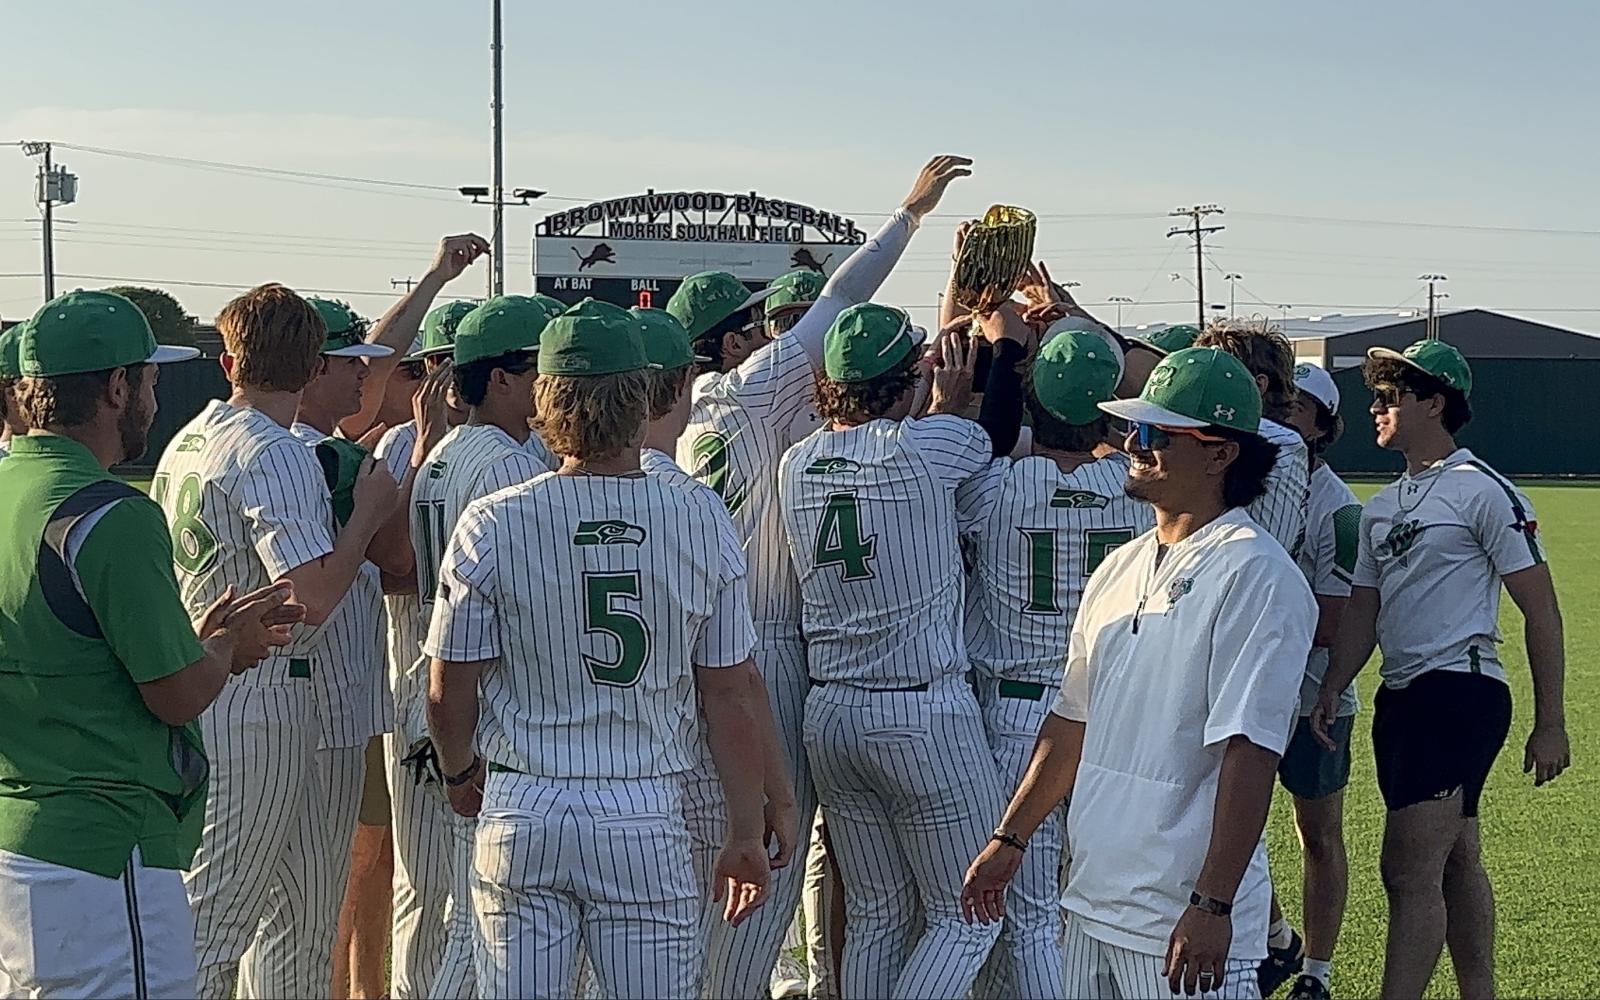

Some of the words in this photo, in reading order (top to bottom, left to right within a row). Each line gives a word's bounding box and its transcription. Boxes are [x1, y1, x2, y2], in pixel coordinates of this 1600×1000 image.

[552, 190, 728, 234] BROWNWOOD
[735, 194, 863, 243] BASEBALL
[608, 221, 671, 239] MORRIS
[675, 223, 756, 242] SOUTHALL
[759, 226, 802, 243] FIELD
[554, 278, 568, 290] AT
[571, 278, 593, 290] BAT
[631, 279, 660, 292] BALL
[812, 489, 879, 583] 4
[582, 569, 652, 689] 5
